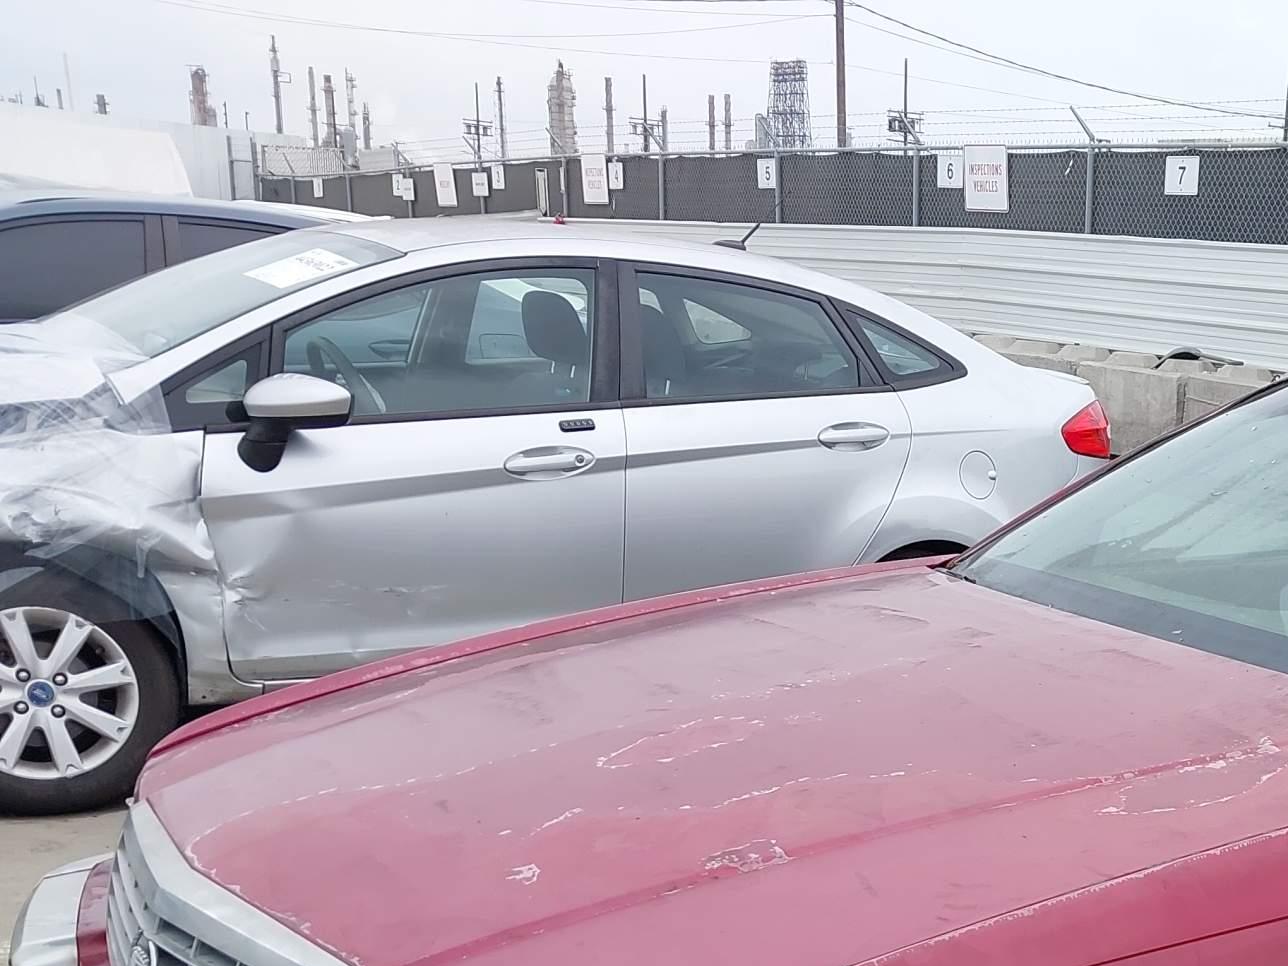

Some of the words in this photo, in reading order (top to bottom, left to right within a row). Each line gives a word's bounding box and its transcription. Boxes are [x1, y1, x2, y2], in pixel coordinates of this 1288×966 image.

[765, 166, 771, 181] 5
[947, 163, 954, 180] 6
[968, 163, 1003, 176] INSPECTIONS
[1178, 166, 1187, 185] 7
[973, 180, 999, 193] VEHICLES
